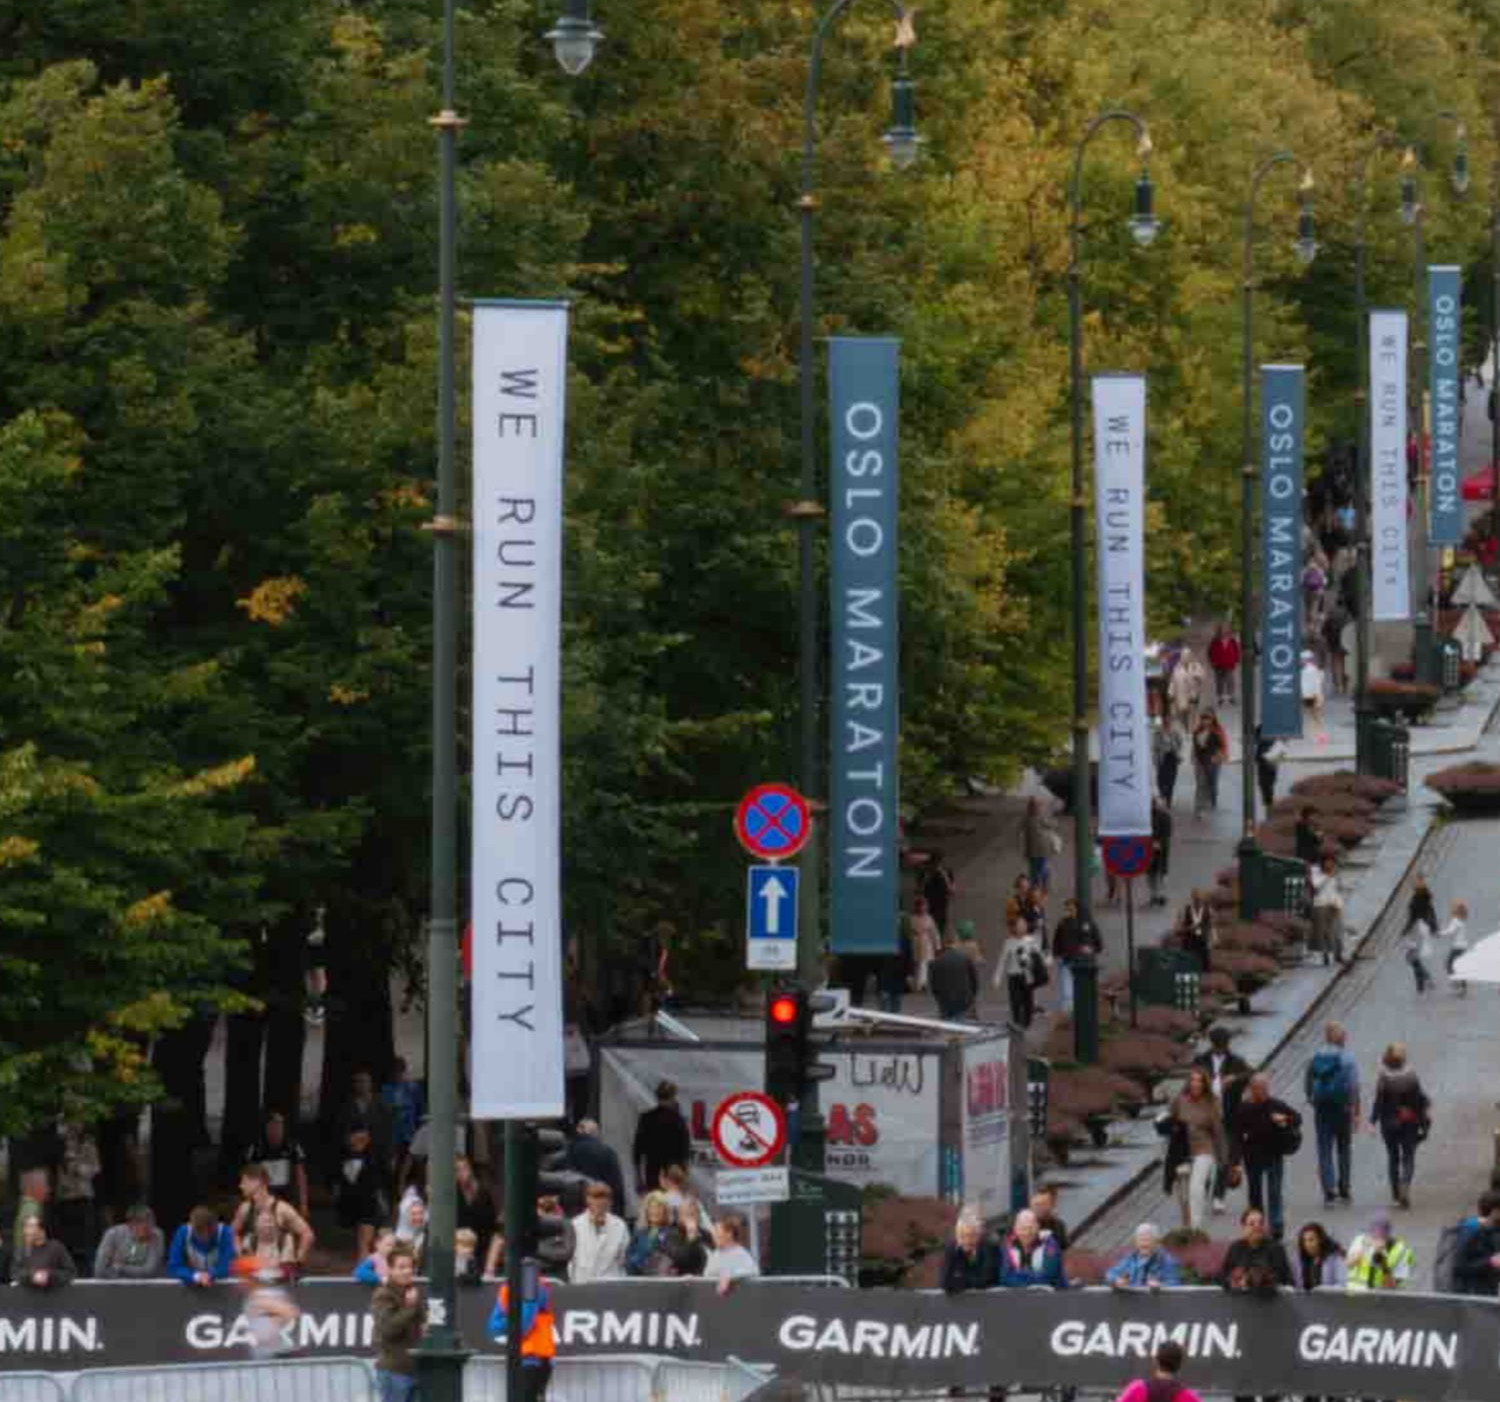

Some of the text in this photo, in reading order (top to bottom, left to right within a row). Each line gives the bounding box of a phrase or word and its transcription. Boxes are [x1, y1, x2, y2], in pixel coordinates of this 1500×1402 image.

[1381, 383, 1397, 428] RUN
[1381, 447, 1399, 509] THIS
[1435, 294, 1457, 513] OSLO MARATON
[845, 402, 884, 878] OSLO MARATON
[1105, 415, 1135, 791] WE RUN THIS CITY
[1268, 403, 1295, 695] OSLO MARATON
[496, 368, 538, 1032] WE RUN THIS CITY
[186, 1313, 374, 1349] GAMI
[1299, 1324, 1458, 1369] GARMIN
